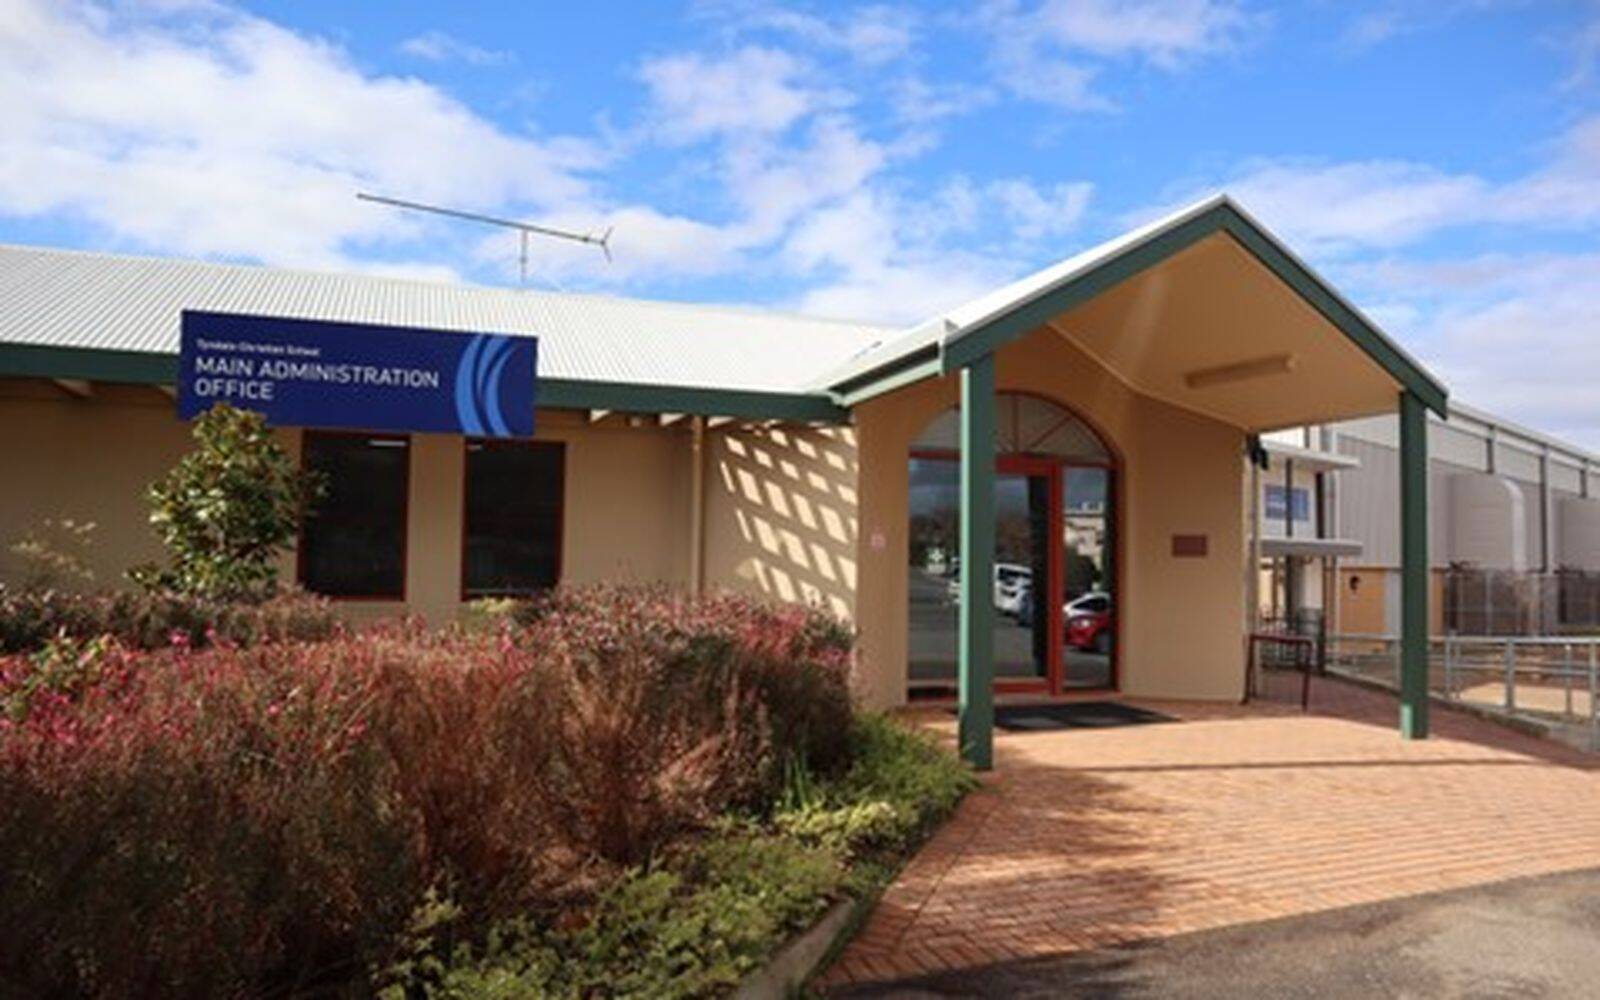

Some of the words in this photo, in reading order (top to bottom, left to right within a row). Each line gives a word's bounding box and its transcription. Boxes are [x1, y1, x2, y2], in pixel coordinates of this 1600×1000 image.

[239, 341, 284, 353] Christian
[287, 345, 320, 356] School
[196, 357, 254, 376] MAIN
[259, 362, 439, 388] ADMINISTRATION
[195, 378, 274, 400] OFFICE
